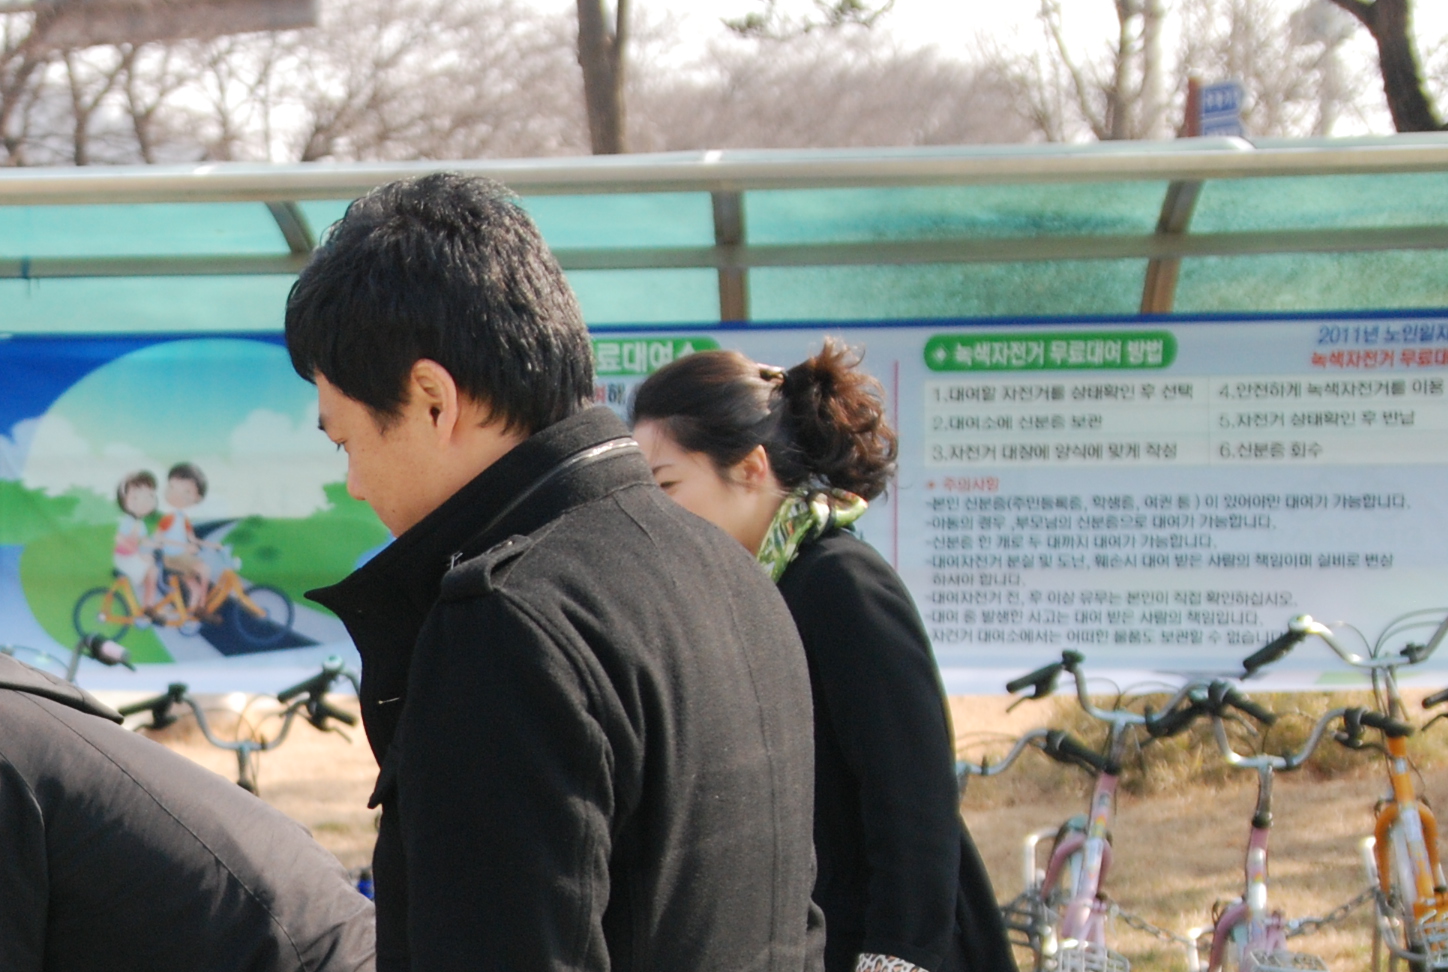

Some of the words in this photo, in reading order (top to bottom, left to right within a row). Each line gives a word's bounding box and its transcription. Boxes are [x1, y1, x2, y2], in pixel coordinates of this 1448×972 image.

[1318, 324, 1379, 345] 2011년
[954, 340, 1044, 367] 녹색자전거
[1051, 340, 1121, 366] 무료대여
[1311, 350, 1394, 368] 녹색자전거
[1003, 384, 1065, 400] 자전거를
[1071, 383, 1135, 399] 상태확인
[1140, 383, 1155, 399] 후
[1162, 382, 1193, 398] 선택
[1307, 380, 1405, 397] 녹색자전거를
[1019, 414, 1065, 430] 신분증
[1290, 410, 1356, 426] 상태확인
[1361, 410, 1376, 426] 후
